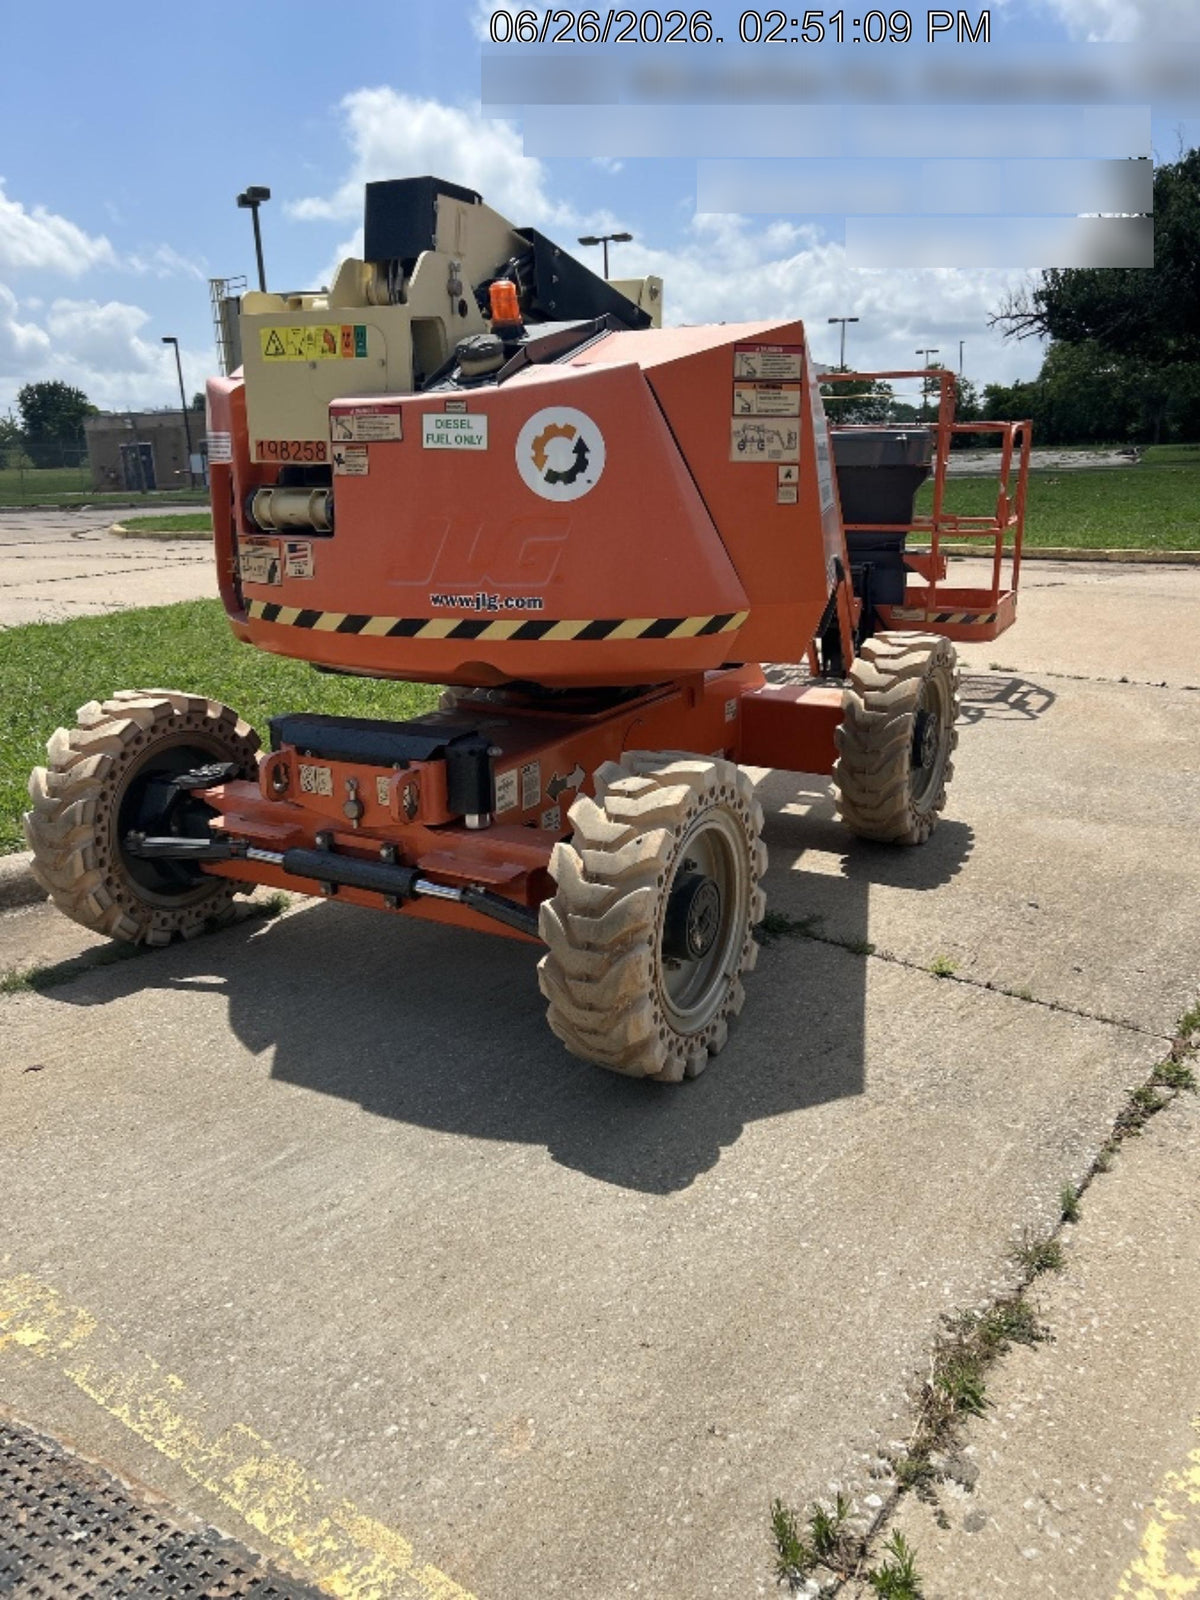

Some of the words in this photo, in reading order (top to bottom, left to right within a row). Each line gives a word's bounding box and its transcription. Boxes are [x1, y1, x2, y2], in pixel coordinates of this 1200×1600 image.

[434, 419, 473, 430] DIESEL
[425, 433, 452, 445] FUEL
[454, 434, 484, 446] ONLY
[257, 440, 327, 461] 198258
[387, 515, 573, 588] JLG
[429, 591, 544, 612] www.jlg.com
